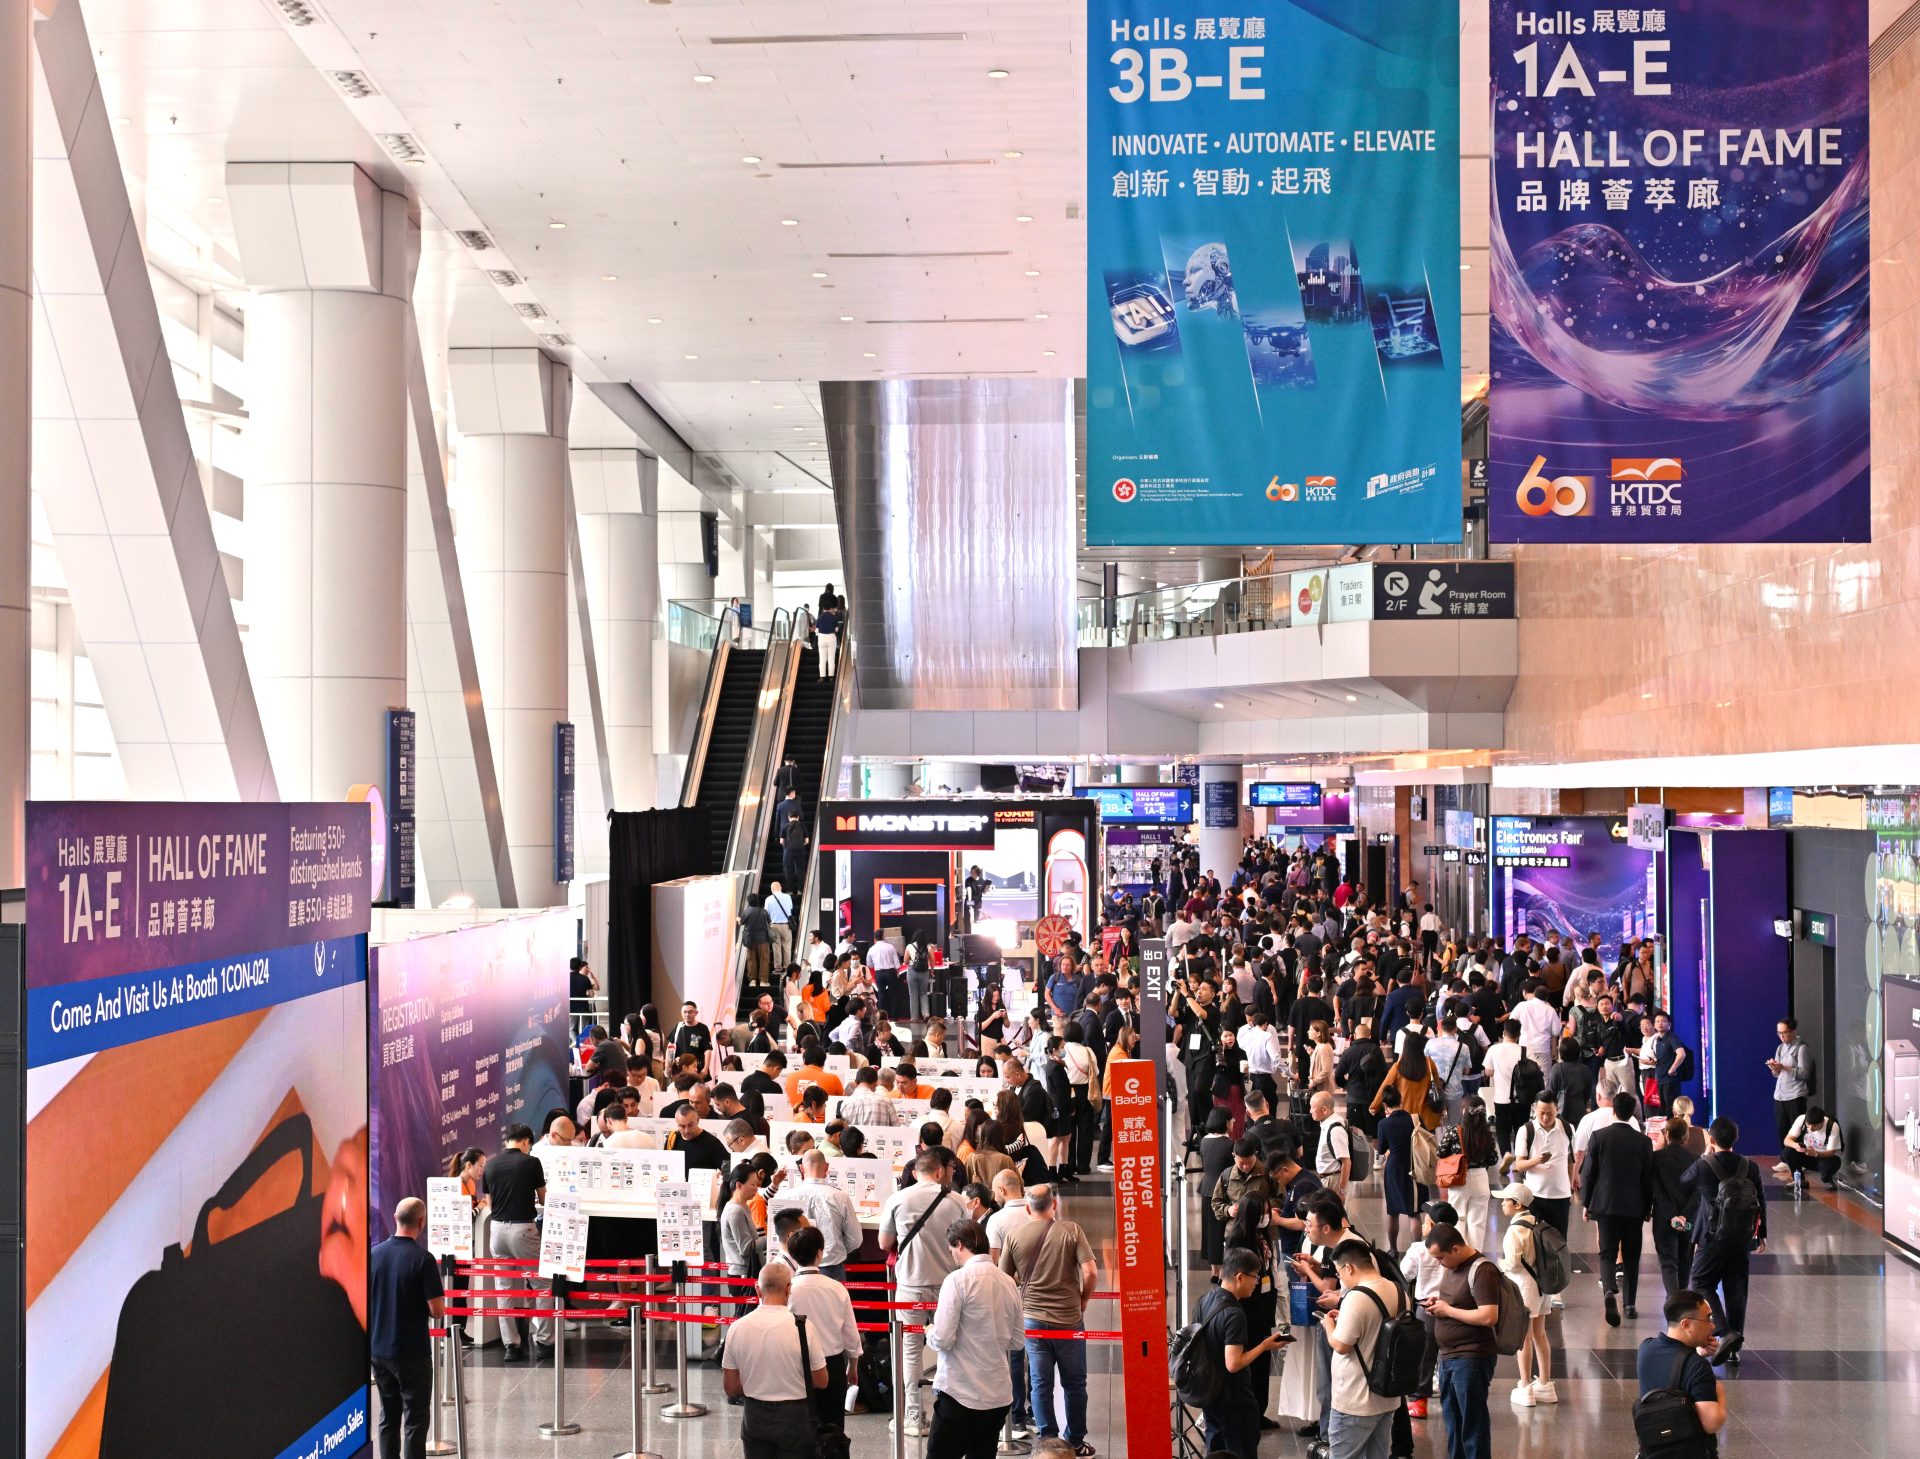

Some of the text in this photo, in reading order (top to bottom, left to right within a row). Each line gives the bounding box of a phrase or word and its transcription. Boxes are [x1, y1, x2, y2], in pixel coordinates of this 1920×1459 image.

[1111, 17, 1266, 41] Halls 展覽廳
[1516, 9, 1666, 35] Halls 展覽廳
[1108, 46, 1266, 103] 3B-E
[1513, 40, 1672, 97] 1A-E
[1112, 130, 1436, 156] INNOVATE AUTOMATE ELEVATE
[1516, 128, 1842, 168] HALL OF FAME
[1305, 487, 1337, 496] HKTDC
[1611, 484, 1681, 504] HKTDC
[1611, 505, 1682, 516] 香港貿發局
[1340, 581, 1363, 591] Traders
[1449, 590, 1506, 601] Prayer Room
[1385, 600, 1407, 612] 2/F
[1449, 603, 1489, 615] 祈禱室
[1144, 806, 1165, 814] 1A-E
[858, 815, 982, 831] MONSTER
[1496, 820, 1531, 830] Hong Kong
[290, 825, 346, 855] Featuring 550+
[1496, 830, 1583, 845] Electronics Fair
[58, 835, 128, 868] Halls 展覽廳
[149, 833, 267, 882] HALL OF FAME
[1496, 845, 1547, 855] (Spring Edition)
[290, 855, 363, 890] distinguished brands
[58, 871, 122, 944] 1A-E
[1144, 949, 1163, 960] 出口
[1147, 964, 1160, 1001] EXIT
[50, 958, 270, 1034] Come And Visit Us At Booth 1CON-024
[382, 997, 435, 1034] REGISTRATION
[1115, 1095, 1152, 1106] Badge
[1122, 1117, 1146, 1130] 買家
[1117, 1130, 1153, 1144] 登記處
[1140, 1156, 1155, 1209] Buyer
[1119, 1157, 1140, 1268] Registration
[323, 1424, 347, 1455] Proven
[347, 1407, 364, 1435] Sales
